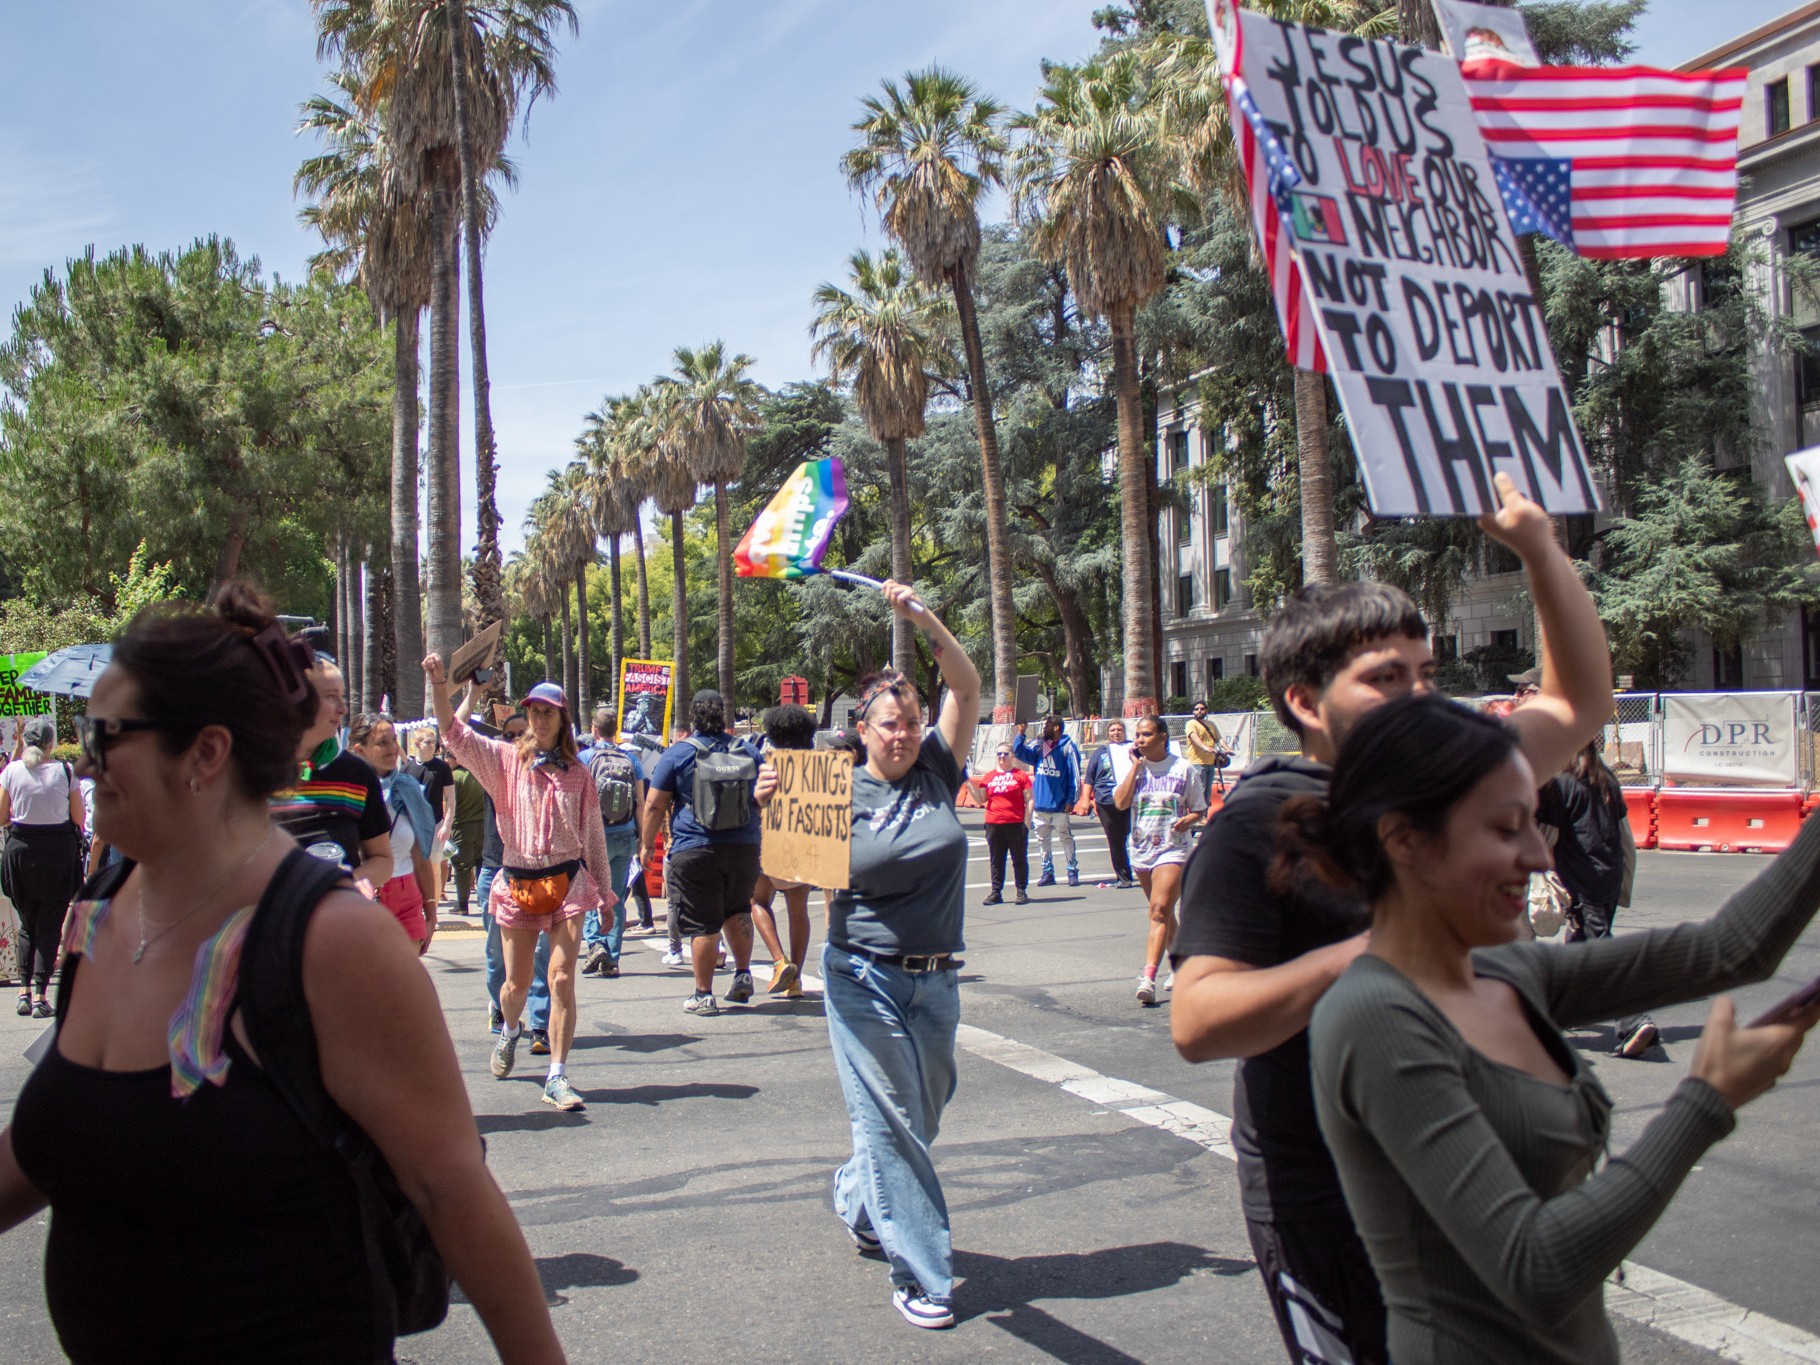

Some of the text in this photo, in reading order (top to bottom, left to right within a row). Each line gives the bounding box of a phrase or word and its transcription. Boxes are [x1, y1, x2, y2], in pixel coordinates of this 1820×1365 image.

[1270, 18, 1438, 101] JESUS
[1266, 68, 1454, 158] TOLD US
[1264, 120, 1494, 213] TO LOVE OUR
[1301, 247, 1389, 312] NOT
[1321, 274, 1544, 375] TO DEPORT
[1363, 373, 1604, 514] THEM
[625, 683, 667, 696] AMERICA
[628, 663, 662, 673] TRUMP
[1699, 723, 1775, 745] DPR
[773, 752, 850, 796] NO KINGS
[992, 773, 1014, 782] ANTI
[765, 797, 783, 832] NO
[788, 797, 849, 842] FASCISTS
